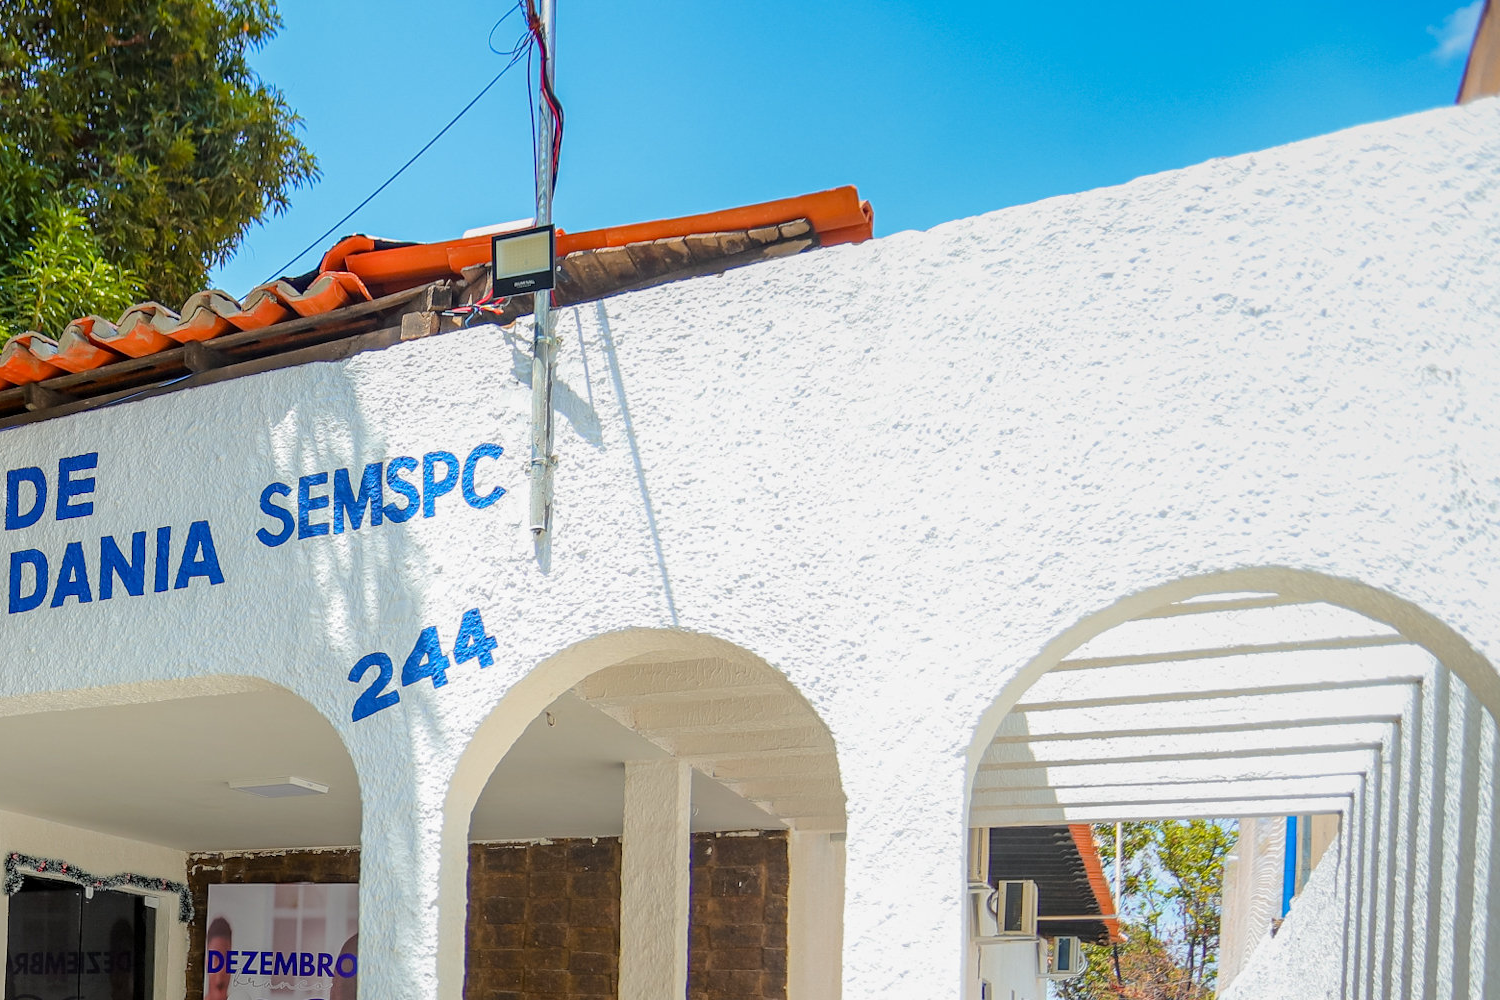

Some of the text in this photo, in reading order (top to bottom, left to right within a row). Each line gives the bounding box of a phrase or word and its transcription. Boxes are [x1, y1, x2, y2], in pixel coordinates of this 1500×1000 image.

[5, 452, 99, 531] DE
[255, 443, 507, 548] SEMSPC
[347, 607, 499, 723] 244
[207, 950, 358, 979] DEZEMBRO
